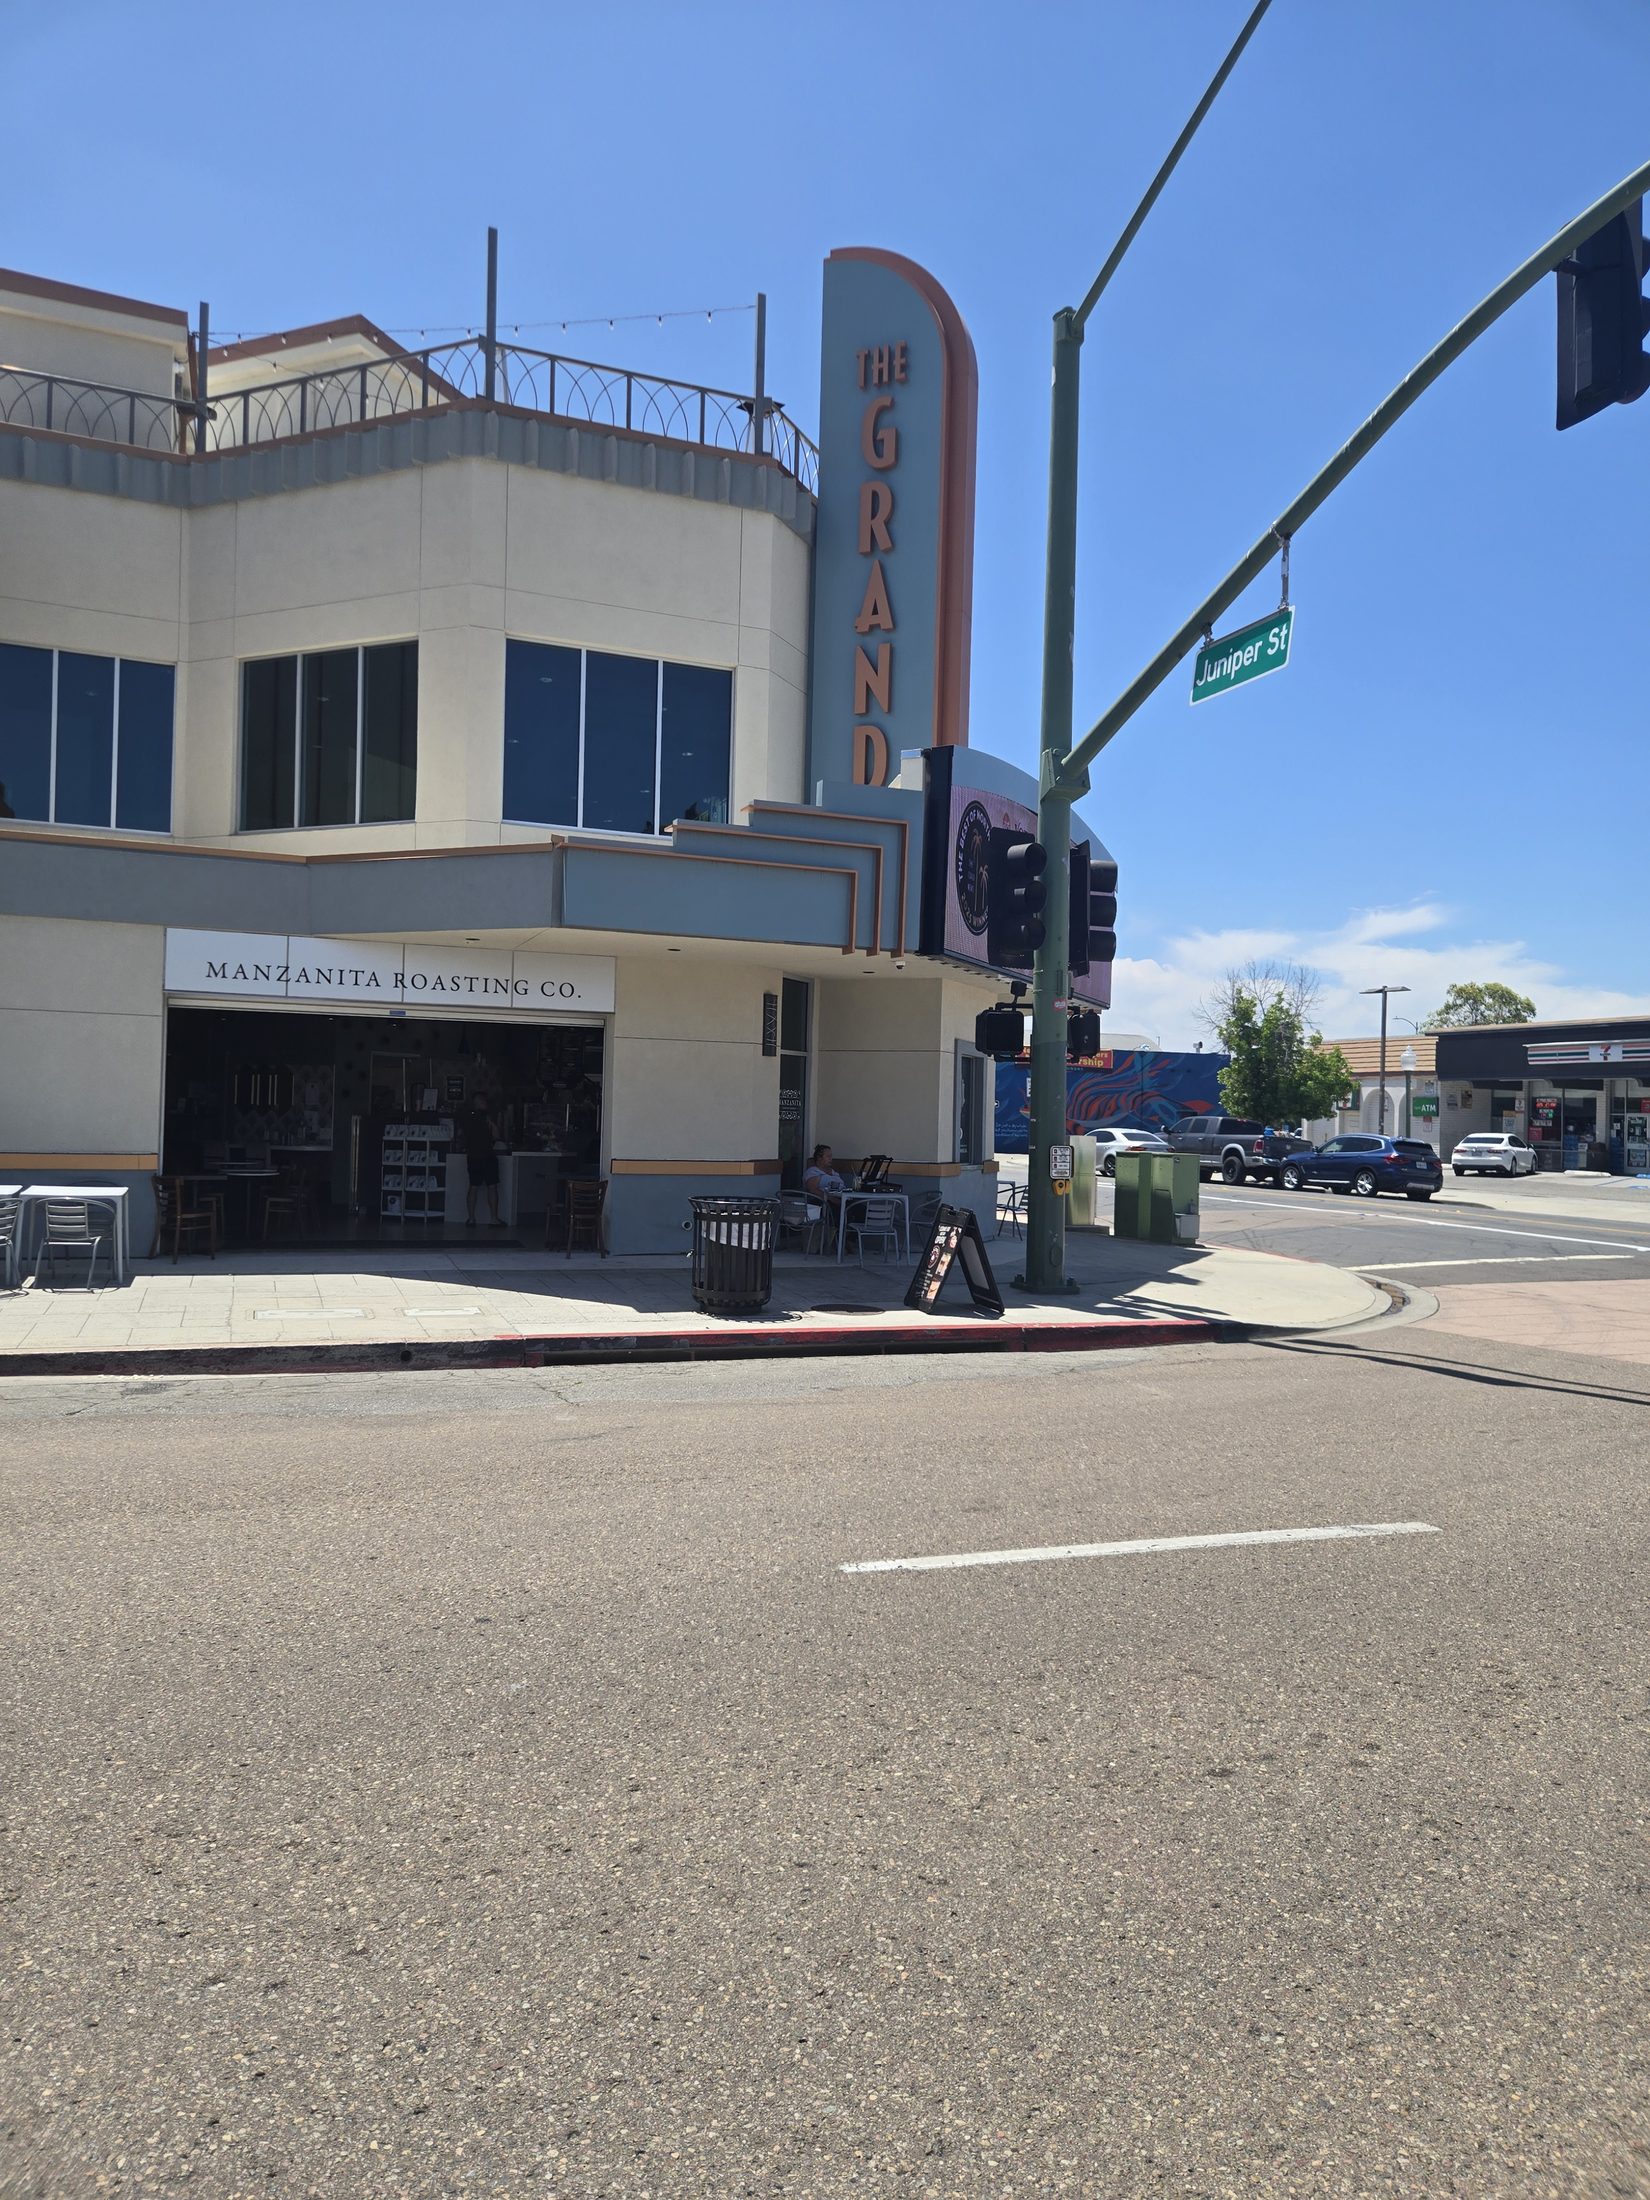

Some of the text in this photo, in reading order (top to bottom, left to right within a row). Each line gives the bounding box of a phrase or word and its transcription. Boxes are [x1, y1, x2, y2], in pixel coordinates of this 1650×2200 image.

[856, 341, 907, 390] THE
[853, 396, 899, 787] GRAND
[1196, 623, 1288, 687] Juniper St
[960, 815, 970, 849] BEST
[970, 809, 977, 823] OF
[205, 961, 582, 999] MANZANITA ROASTING CO.
[1079, 1058, 1104, 1068] rship
[1421, 1104, 1437, 1112] ATM
